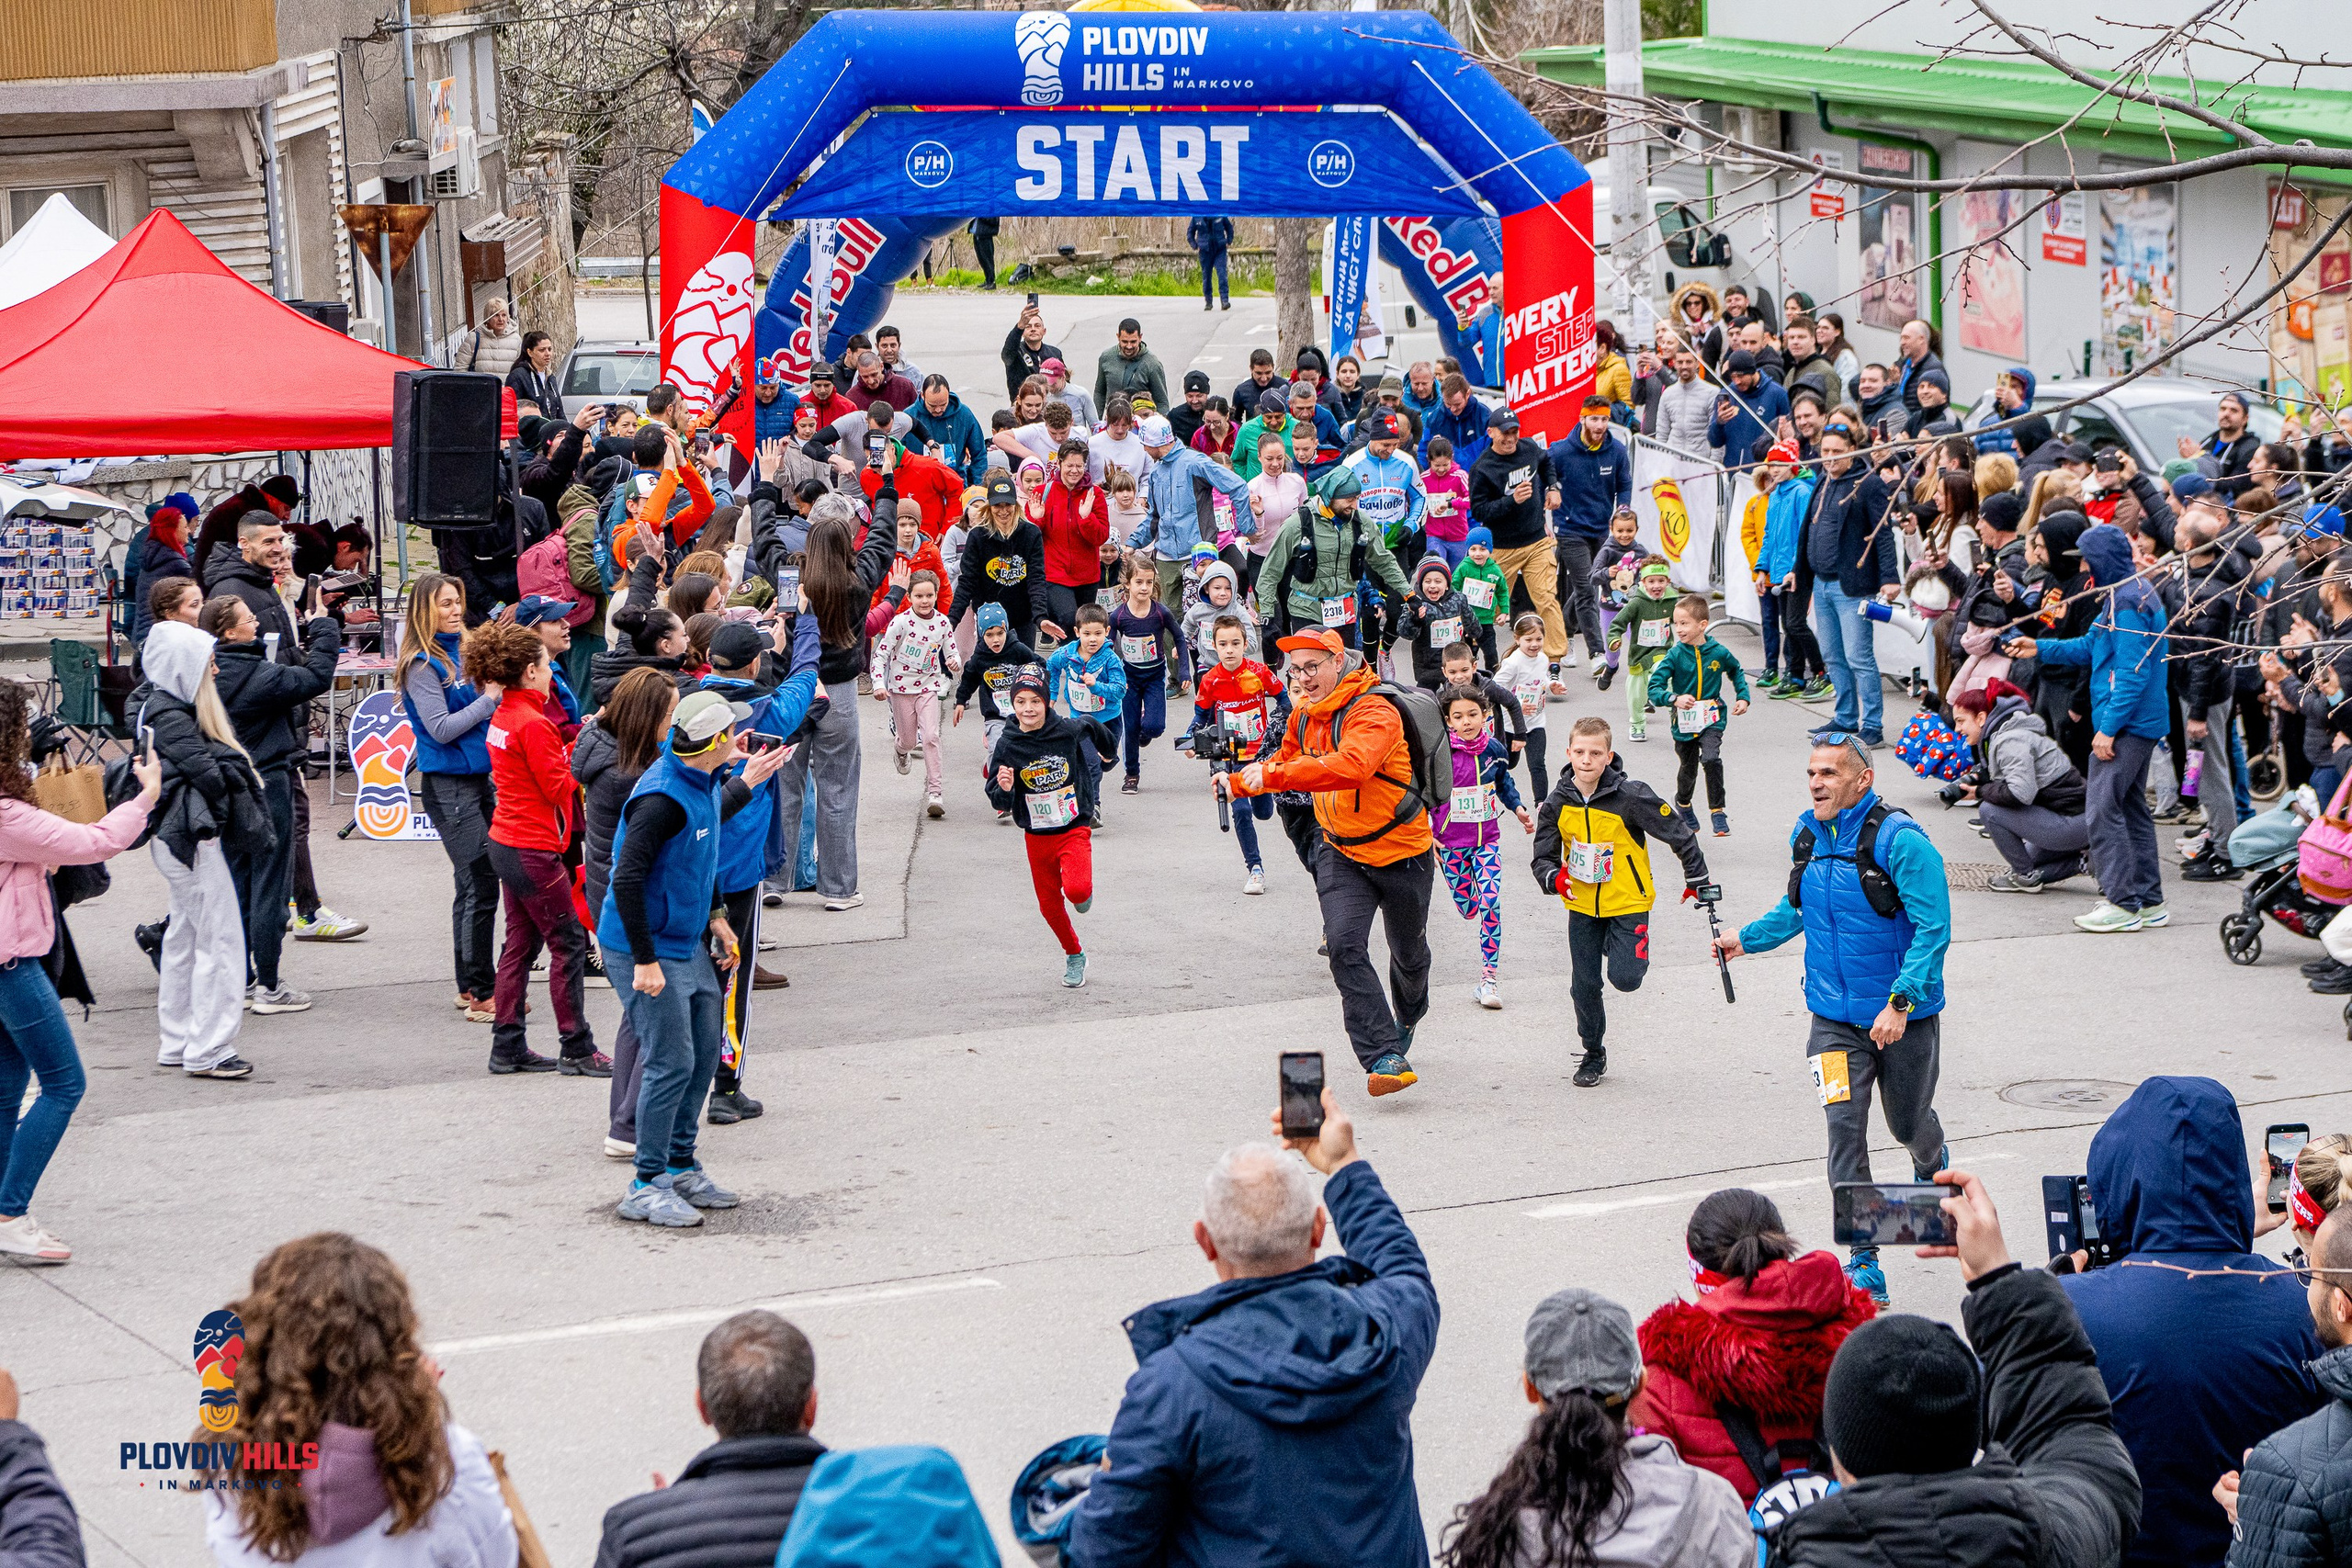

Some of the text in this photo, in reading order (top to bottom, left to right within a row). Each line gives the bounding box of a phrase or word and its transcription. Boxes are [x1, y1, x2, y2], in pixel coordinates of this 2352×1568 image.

[1082, 27, 1209, 56] PLOVDIV
[1082, 63, 1190, 91] HILLS IN
[1173, 79, 1254, 89] MARKOVO
[914, 155, 944, 171] P/H
[1015, 125, 1250, 201] START
[1317, 154, 1347, 171] P/H
[1346, 252, 1360, 306] ЧИСТ
[1334, 261, 1347, 328] ЦЕННИ
[1344, 310, 1355, 336] ЗА
[1504, 285, 1579, 348] EVERY
[1535, 305, 1595, 364] STEP
[1510, 465, 1531, 487] NIKE
[1324, 605, 1343, 617] 2318
[1435, 627, 1450, 638] 179
[1641, 628, 1656, 637] 130
[905, 644, 922, 658] 180
[1124, 643, 1136, 653] 125
[1070, 689, 1085, 701] 187
[1681, 711, 1697, 721] 177
[1036, 769, 1067, 786] PARK
[1034, 804, 1052, 815] 120
[1458, 797, 1476, 810] 131
[1572, 850, 1586, 867] 175
